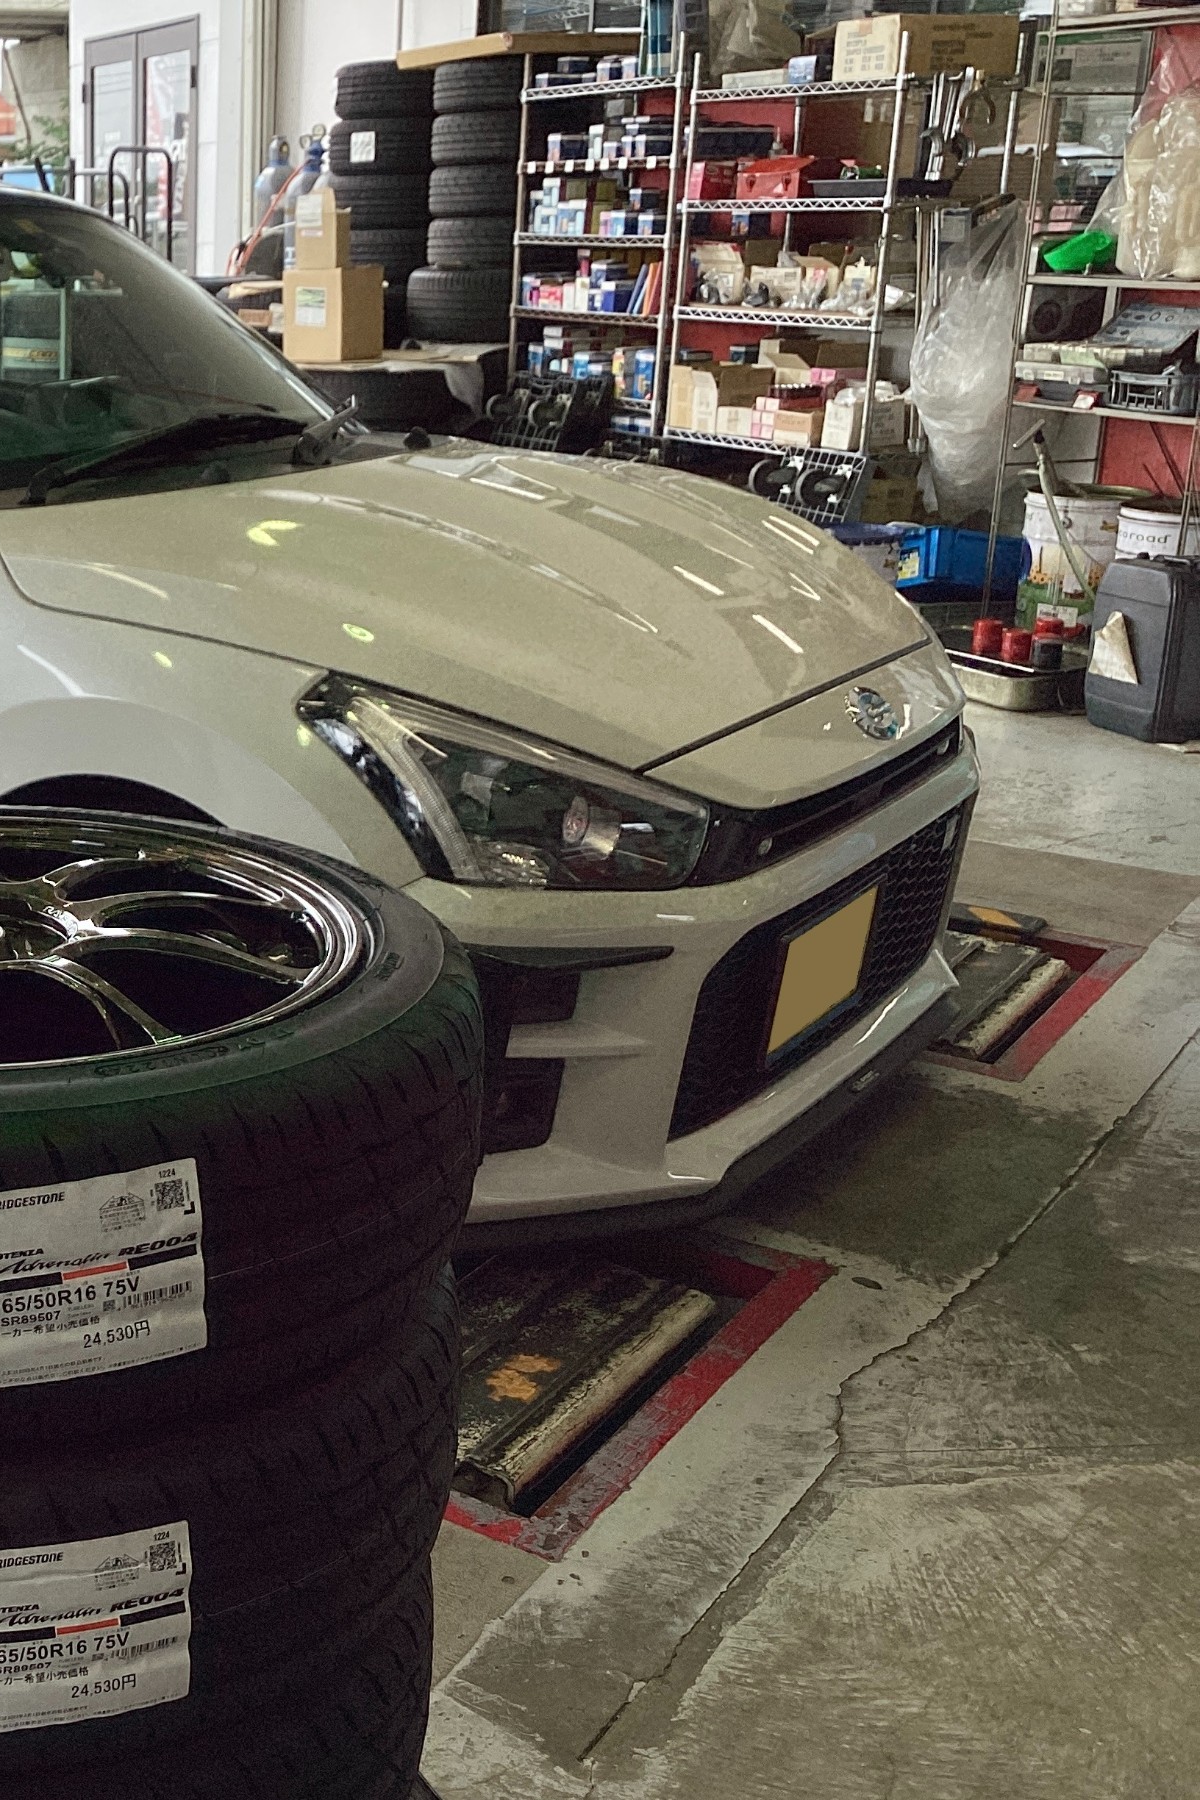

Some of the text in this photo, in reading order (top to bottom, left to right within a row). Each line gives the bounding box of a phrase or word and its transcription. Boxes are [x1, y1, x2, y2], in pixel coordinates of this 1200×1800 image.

[158, 1168, 176, 1179] 1224
[117, 1232, 198, 1257] RE004
[102, 1275, 141, 1298] 75V
[83, 1319, 151, 1349] 24,530円
[153, 1530, 170, 1541] 1224
[109, 1587, 184, 1613] RE004
[93, 1631, 130, 1650] 75V
[71, 1673, 137, 1699] 24,530円
